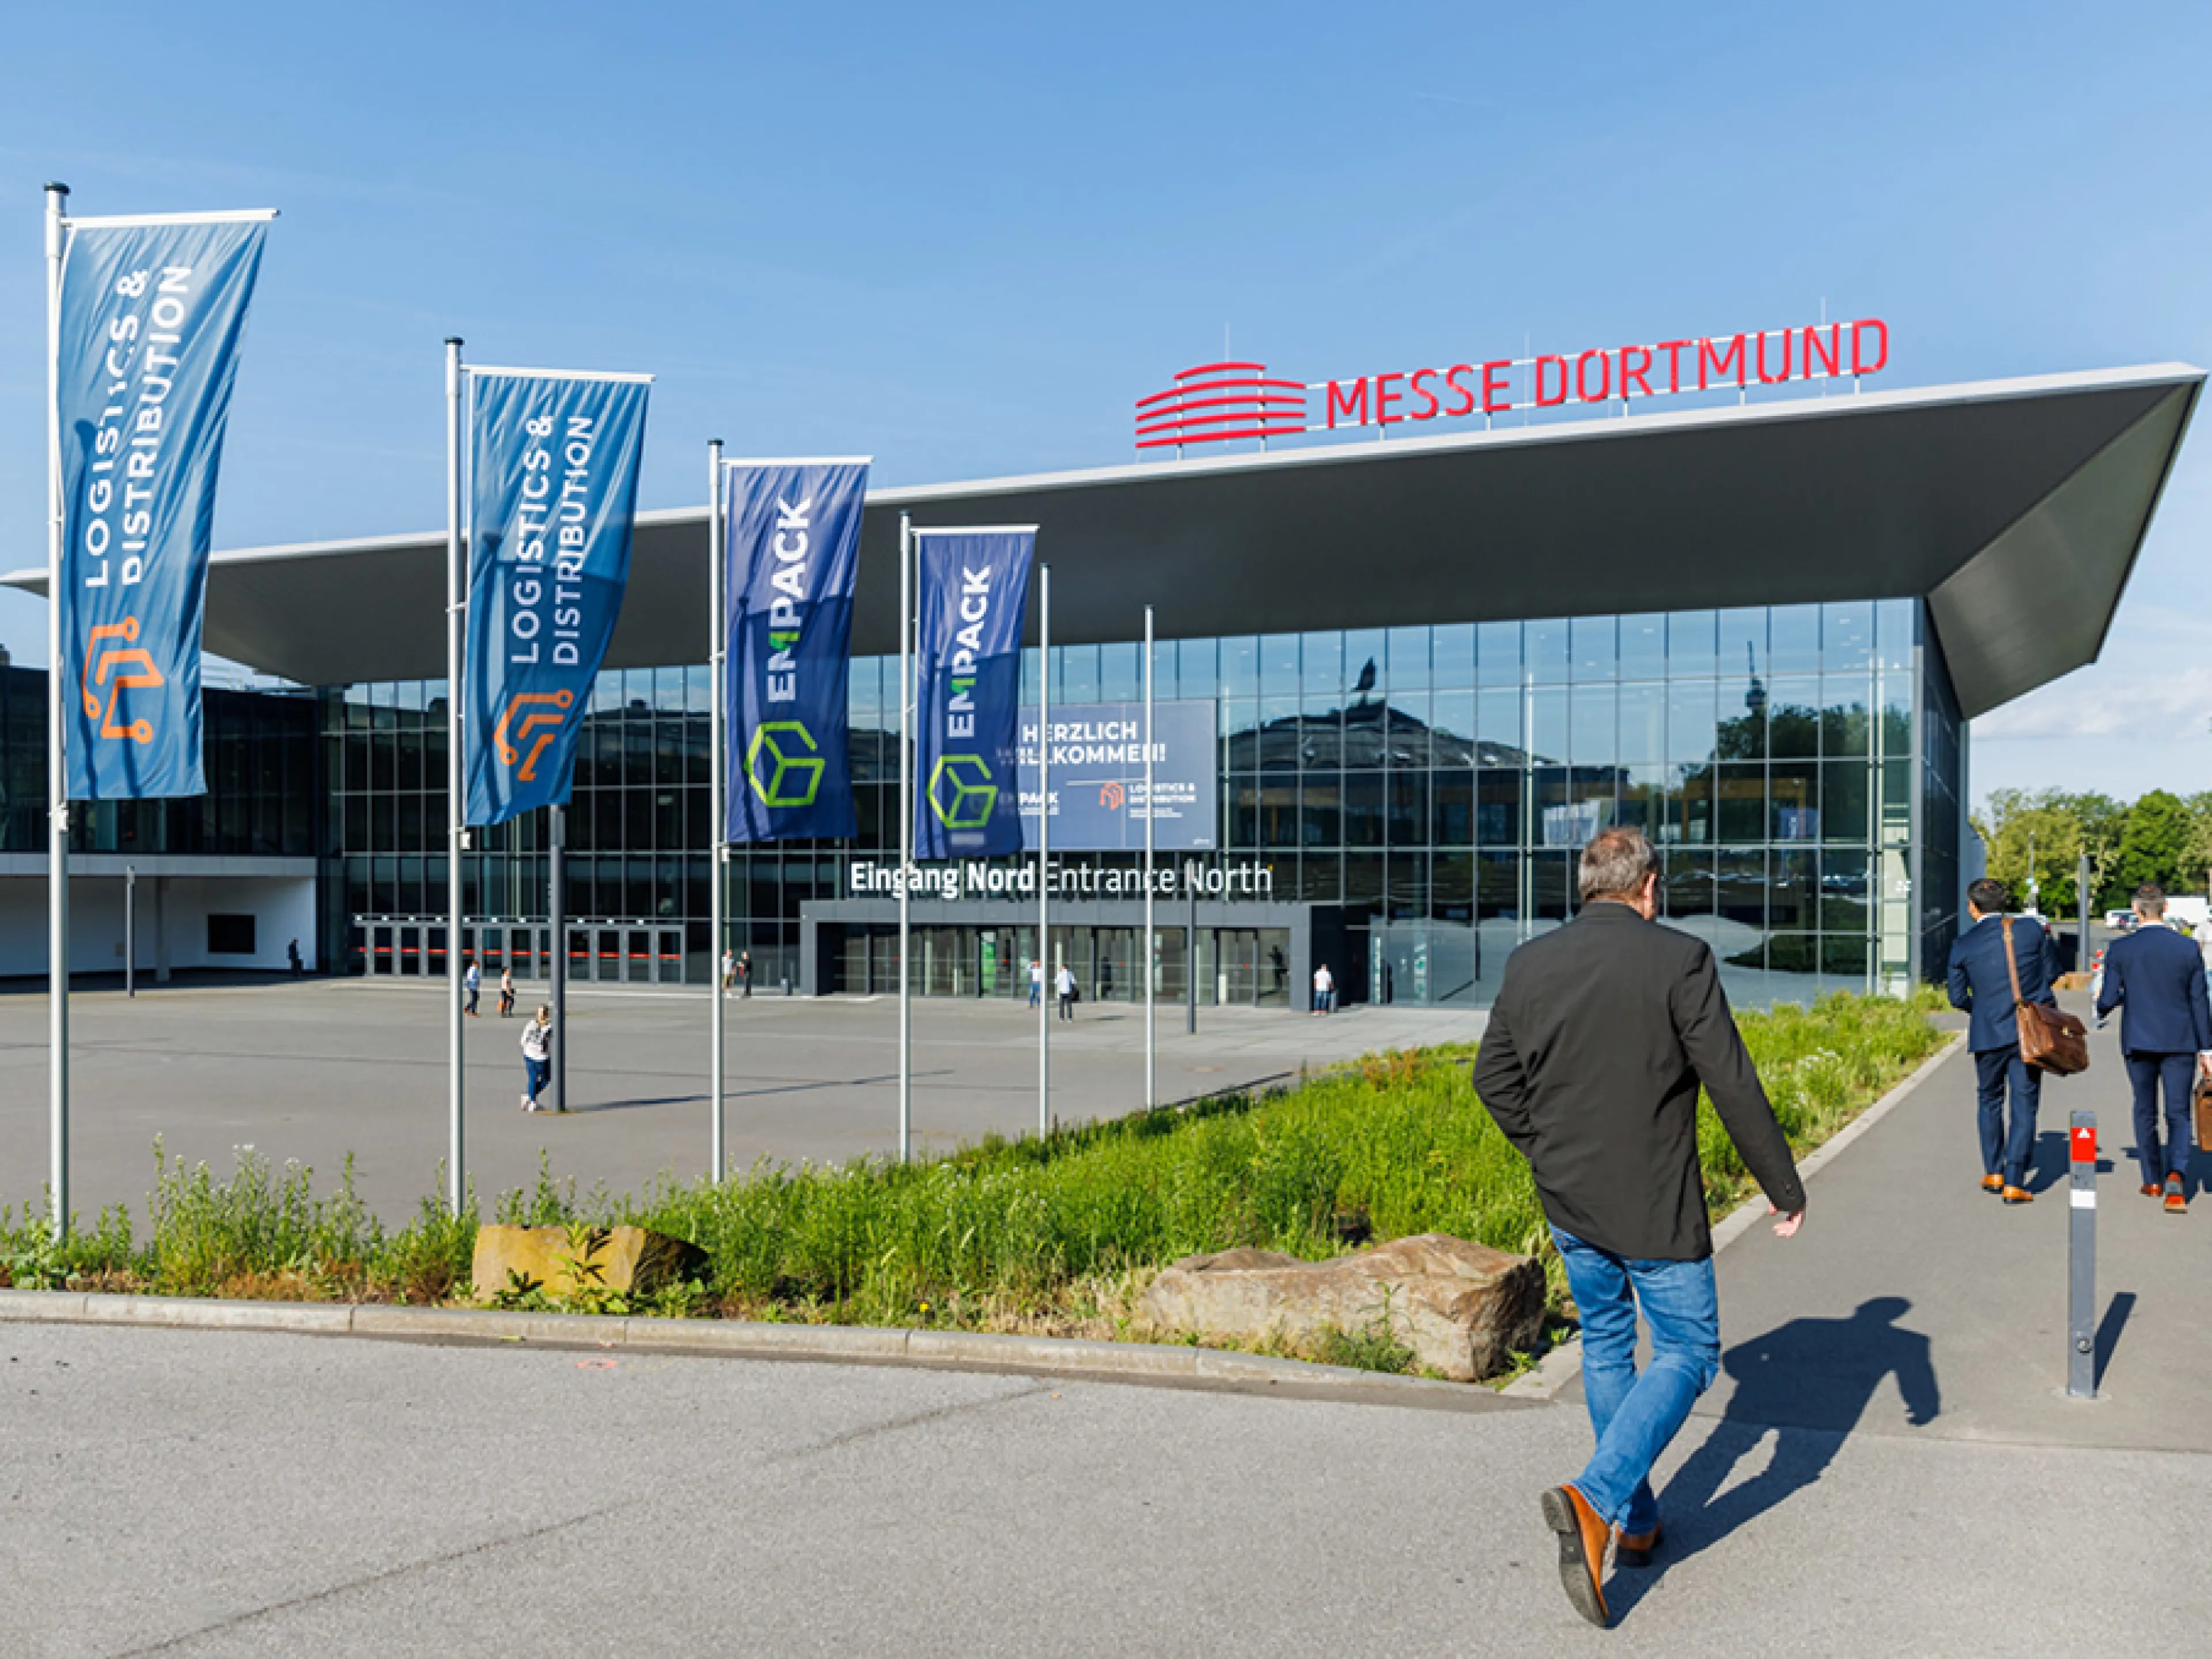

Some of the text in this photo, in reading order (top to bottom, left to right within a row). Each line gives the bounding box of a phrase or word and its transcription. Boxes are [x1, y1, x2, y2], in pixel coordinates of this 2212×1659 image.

[85, 269, 147, 588] LOGISTICS &
[122, 267, 192, 585] DISTRIBUTION
[1326, 318, 1888, 429] MESSE DORTMUND
[511, 416, 553, 665] LOGISTICS &
[552, 416, 593, 666] DISTRIBUTION
[767, 497, 810, 703] EMPACK
[948, 565, 991, 738] EMPACK
[1022, 720, 1138, 743] HERZLICH
[850, 860, 1272, 899] Eingang Nord Entrance North
